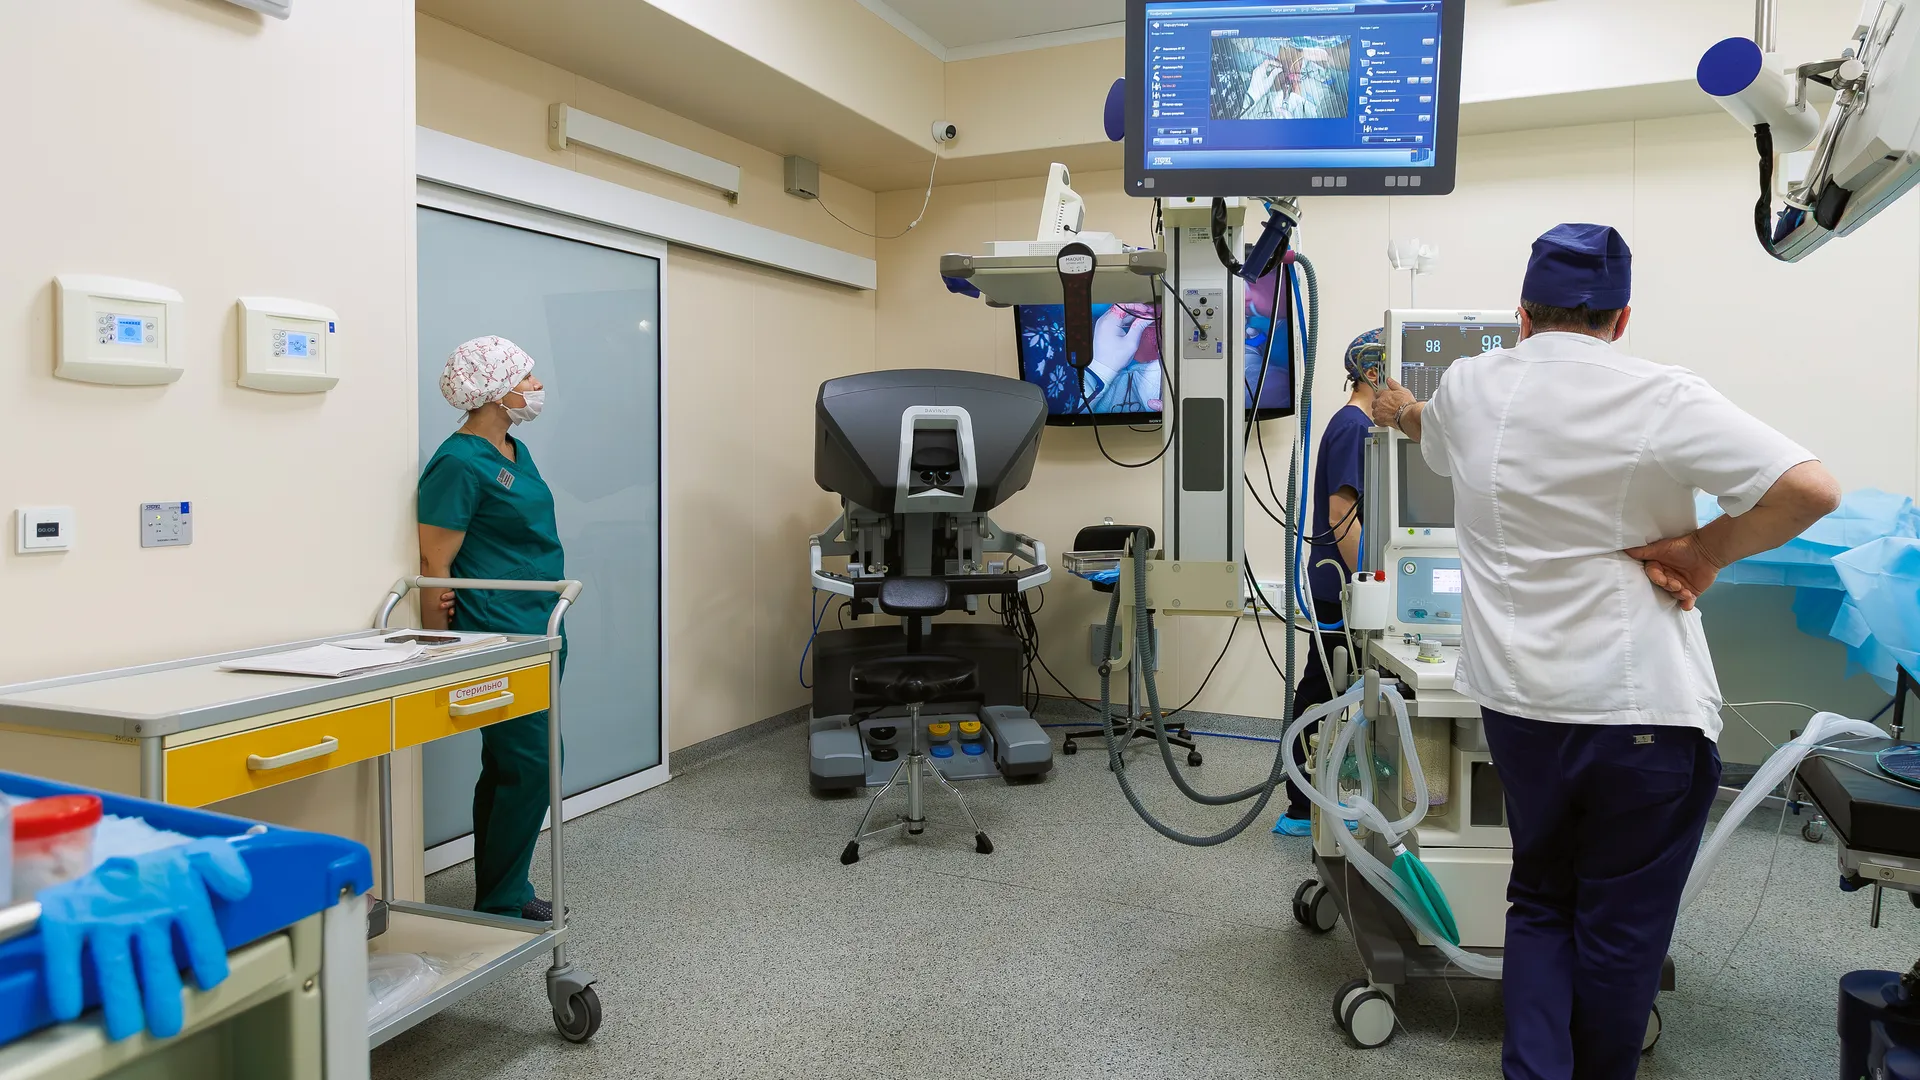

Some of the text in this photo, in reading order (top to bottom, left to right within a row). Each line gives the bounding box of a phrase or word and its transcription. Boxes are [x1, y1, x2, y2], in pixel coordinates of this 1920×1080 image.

[1425, 340, 1441, 353] 98
[1481, 335, 1502, 352] 98
[456, 679, 503, 699] Стерильно
